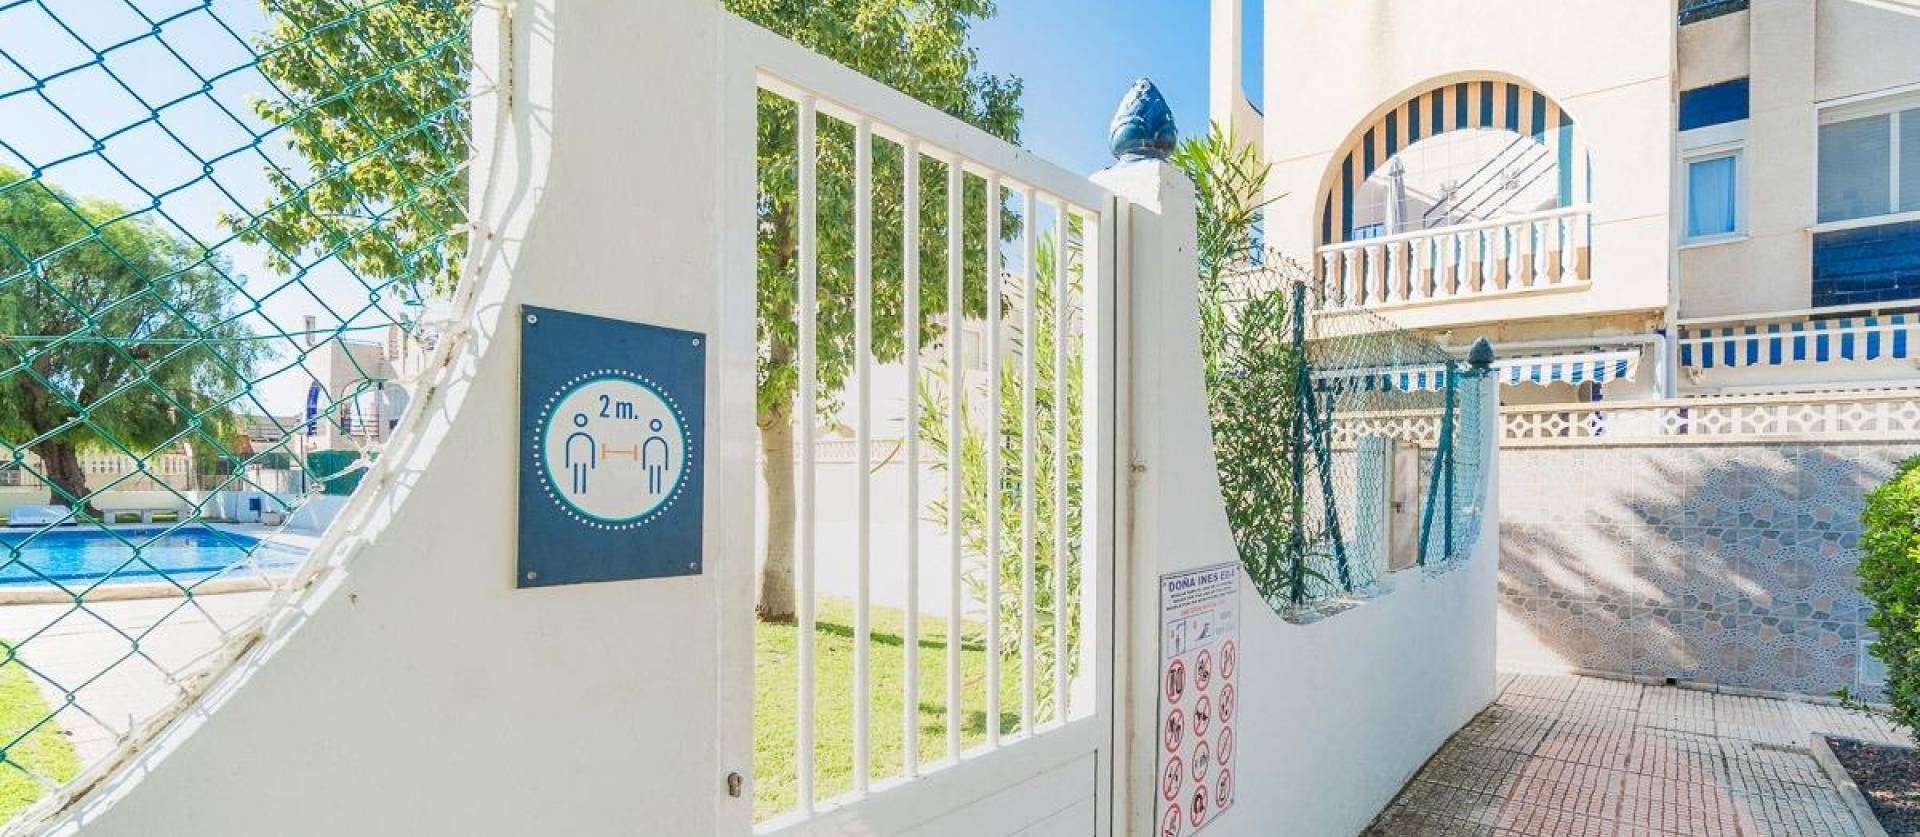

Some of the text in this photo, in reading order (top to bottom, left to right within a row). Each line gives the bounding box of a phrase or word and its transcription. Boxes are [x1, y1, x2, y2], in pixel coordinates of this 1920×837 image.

[600, 395, 638, 419] 2 m.
[1169, 577, 1196, 592] DOÑA
[1198, 573, 1218, 585] INES
